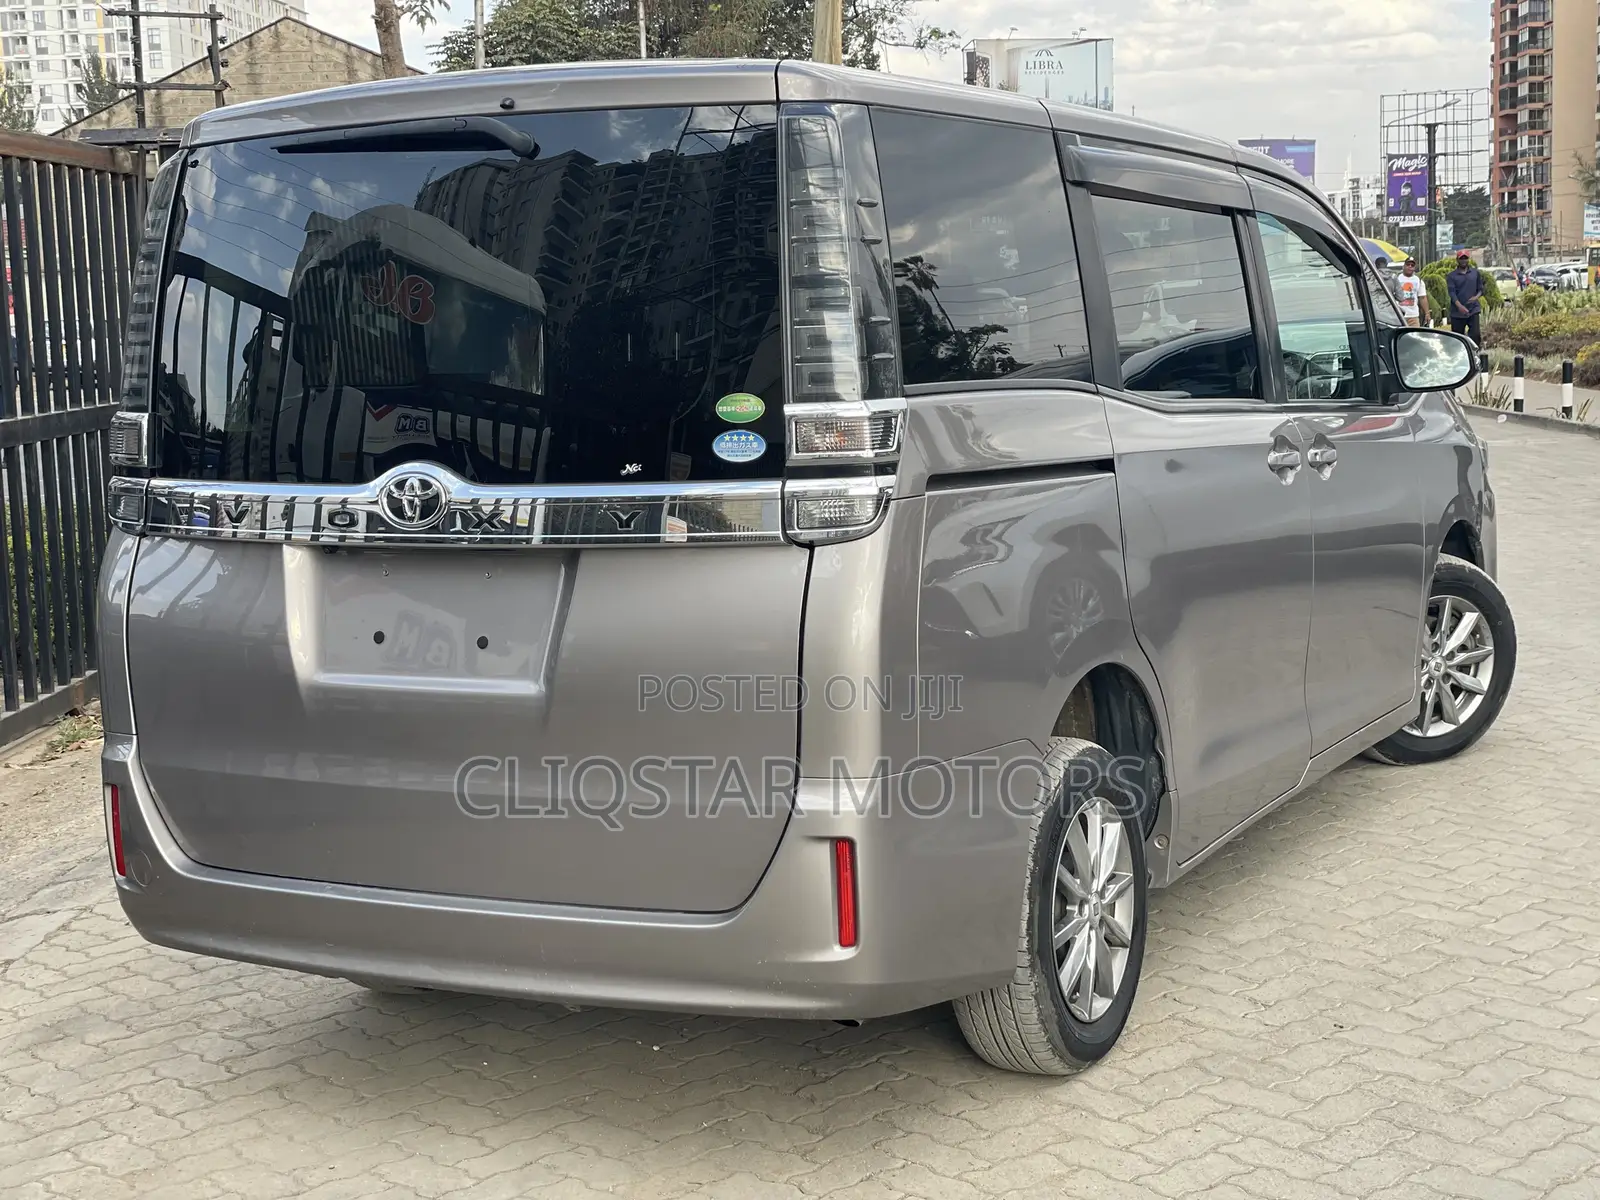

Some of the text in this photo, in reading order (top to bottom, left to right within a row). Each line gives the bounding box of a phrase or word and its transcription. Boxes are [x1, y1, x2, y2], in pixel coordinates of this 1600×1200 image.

[1025, 60, 1063, 70] LIBRA
[1388, 154, 1428, 171] Magic
[222, 504, 643, 531] VOXY
